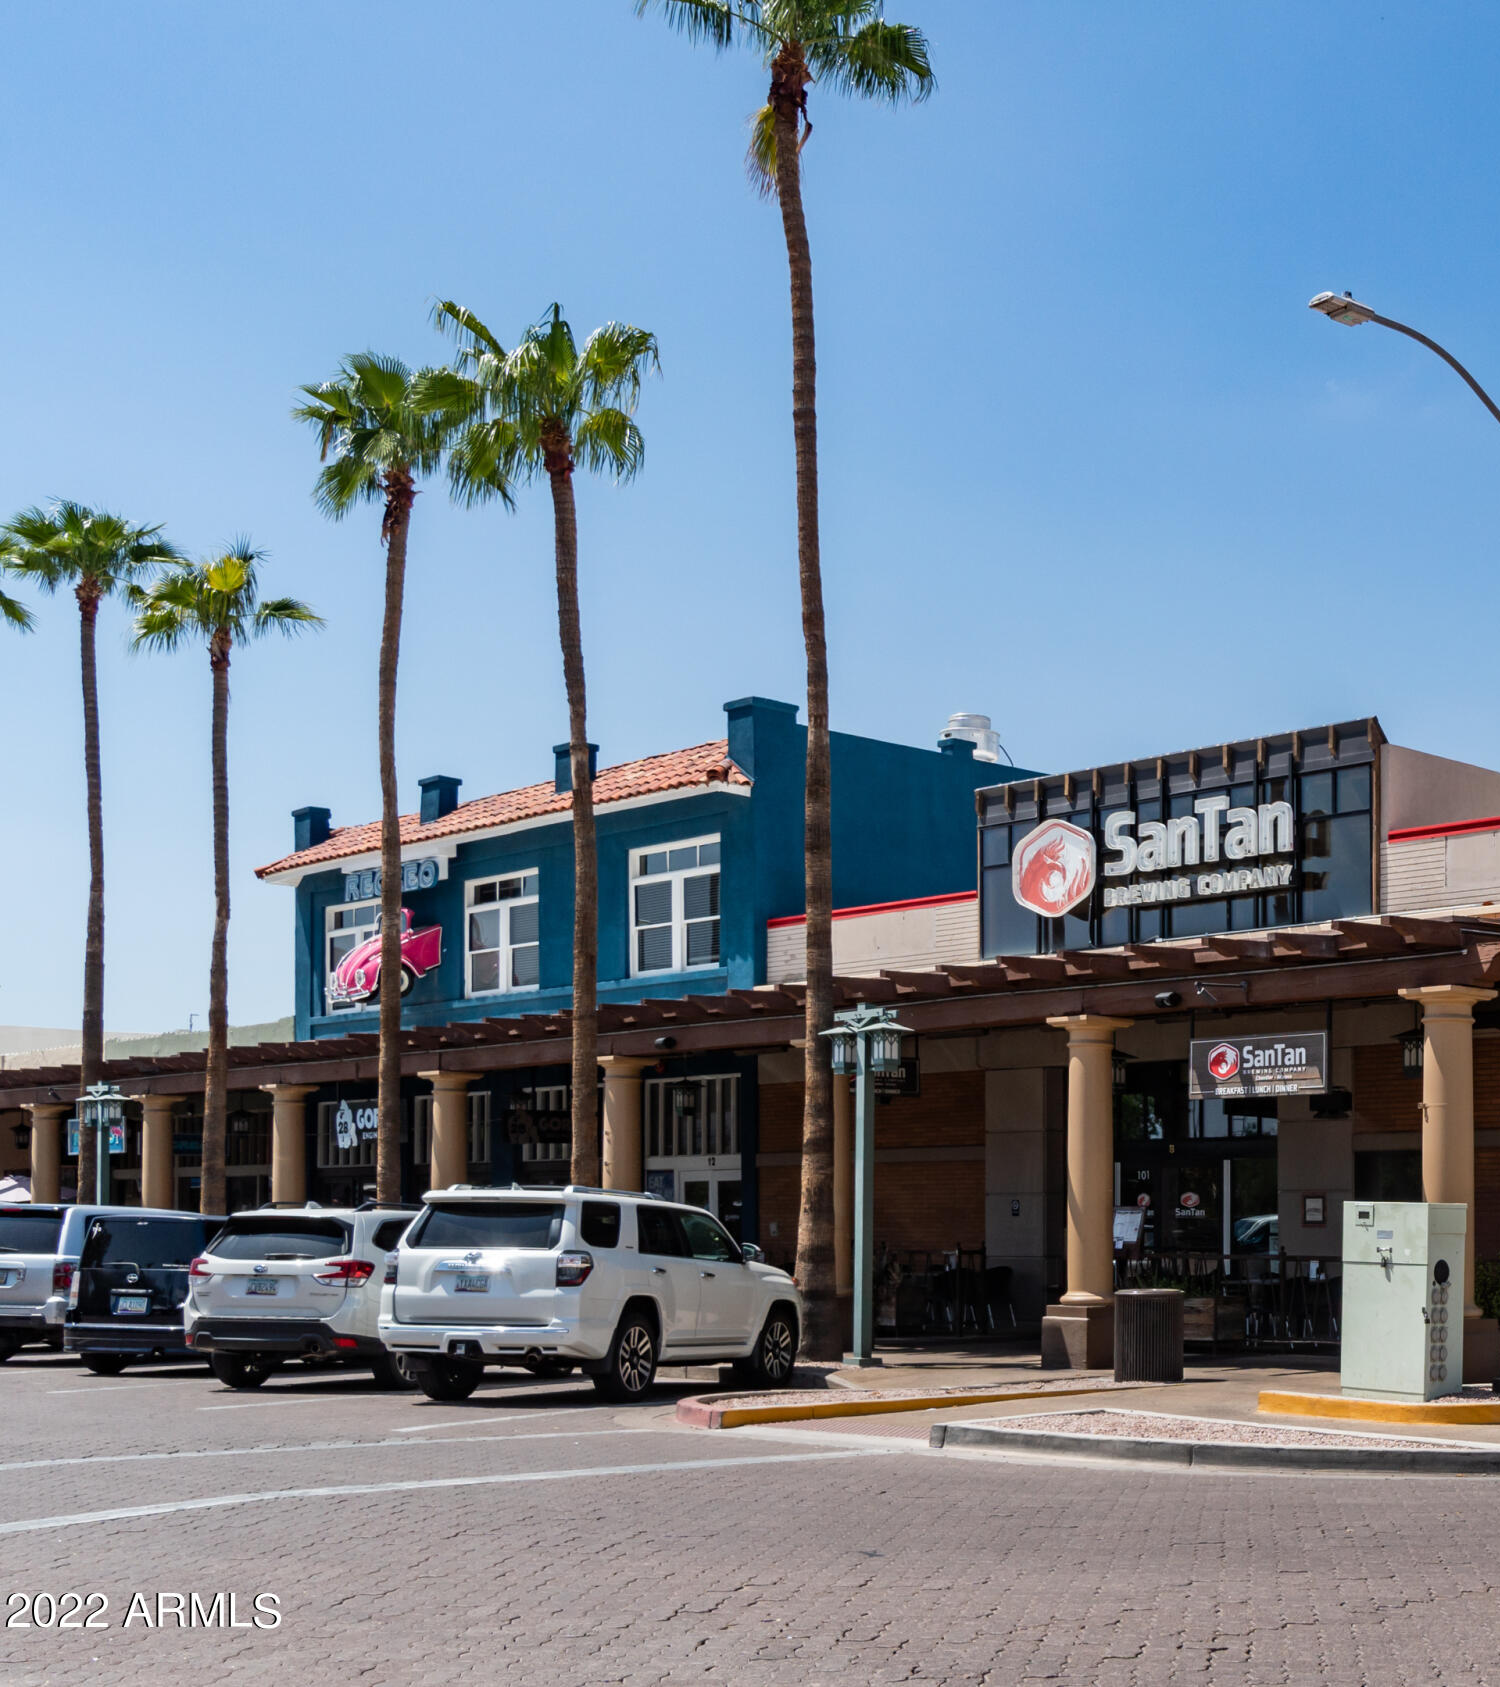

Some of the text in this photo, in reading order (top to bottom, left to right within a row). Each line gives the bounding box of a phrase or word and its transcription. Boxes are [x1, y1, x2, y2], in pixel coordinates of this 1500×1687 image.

[1104, 795, 1294, 876] SanTan
[344, 859, 437, 902] RECEO
[1104, 864, 1293, 907] BREWING COMPANY
[1242, 1044, 1306, 1068] SanTan
[1215, 1084, 1298, 1095] BREAKFAST LUNCH DINNER
[338, 1122, 348, 1135] 28
[1137, 1170, 1150, 1181] 101
[1175, 1208, 1206, 1217] SanTan
